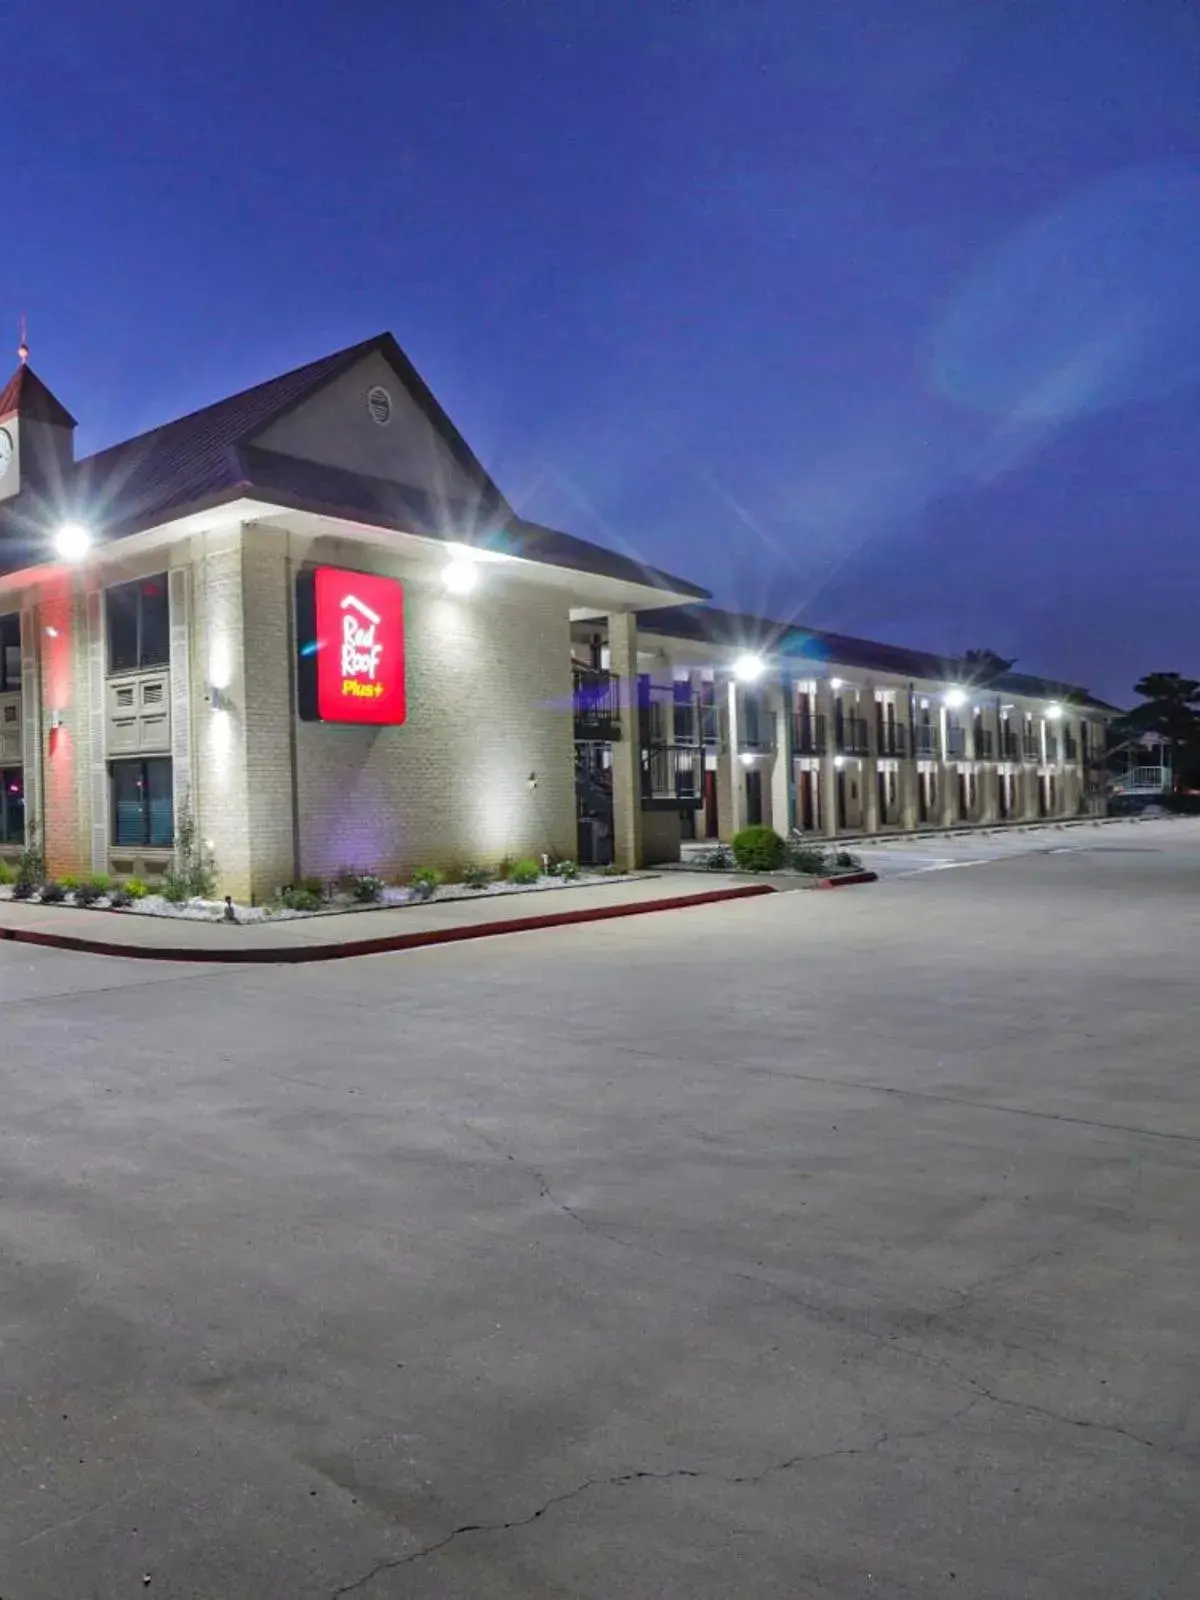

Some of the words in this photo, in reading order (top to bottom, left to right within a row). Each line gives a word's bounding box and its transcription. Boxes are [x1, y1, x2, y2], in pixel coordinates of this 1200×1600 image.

[343, 615, 375, 647] Red
[341, 644, 383, 679] Roof
[342, 680, 383, 697] Plus+
